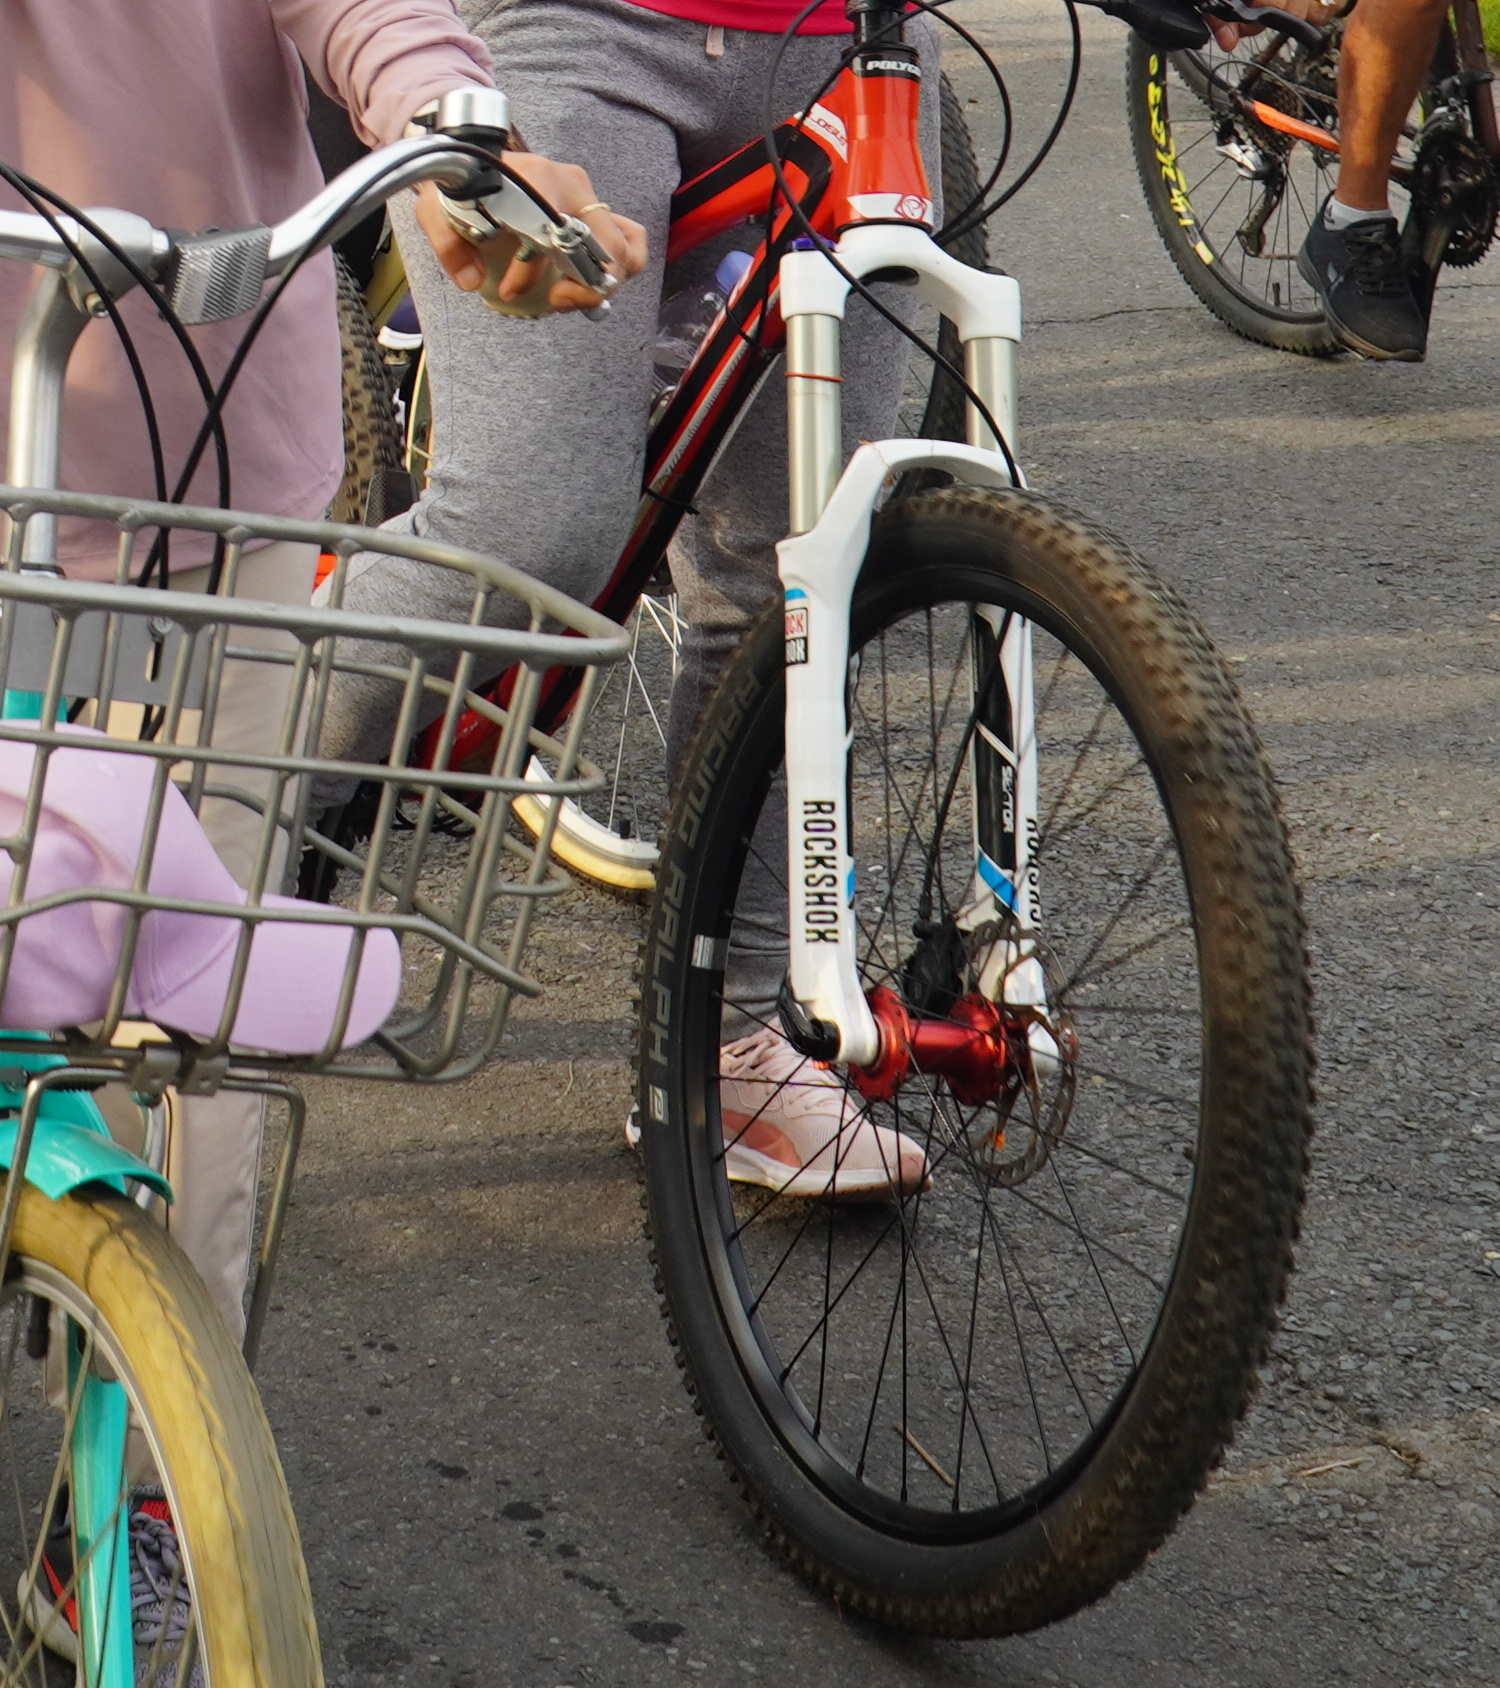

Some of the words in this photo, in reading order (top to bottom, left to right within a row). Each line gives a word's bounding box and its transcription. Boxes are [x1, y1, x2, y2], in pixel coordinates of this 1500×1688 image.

[677, 669, 764, 850] RACING
[802, 799, 841, 945] ROCKSHOX
[647, 868, 688, 1067] RALPH
